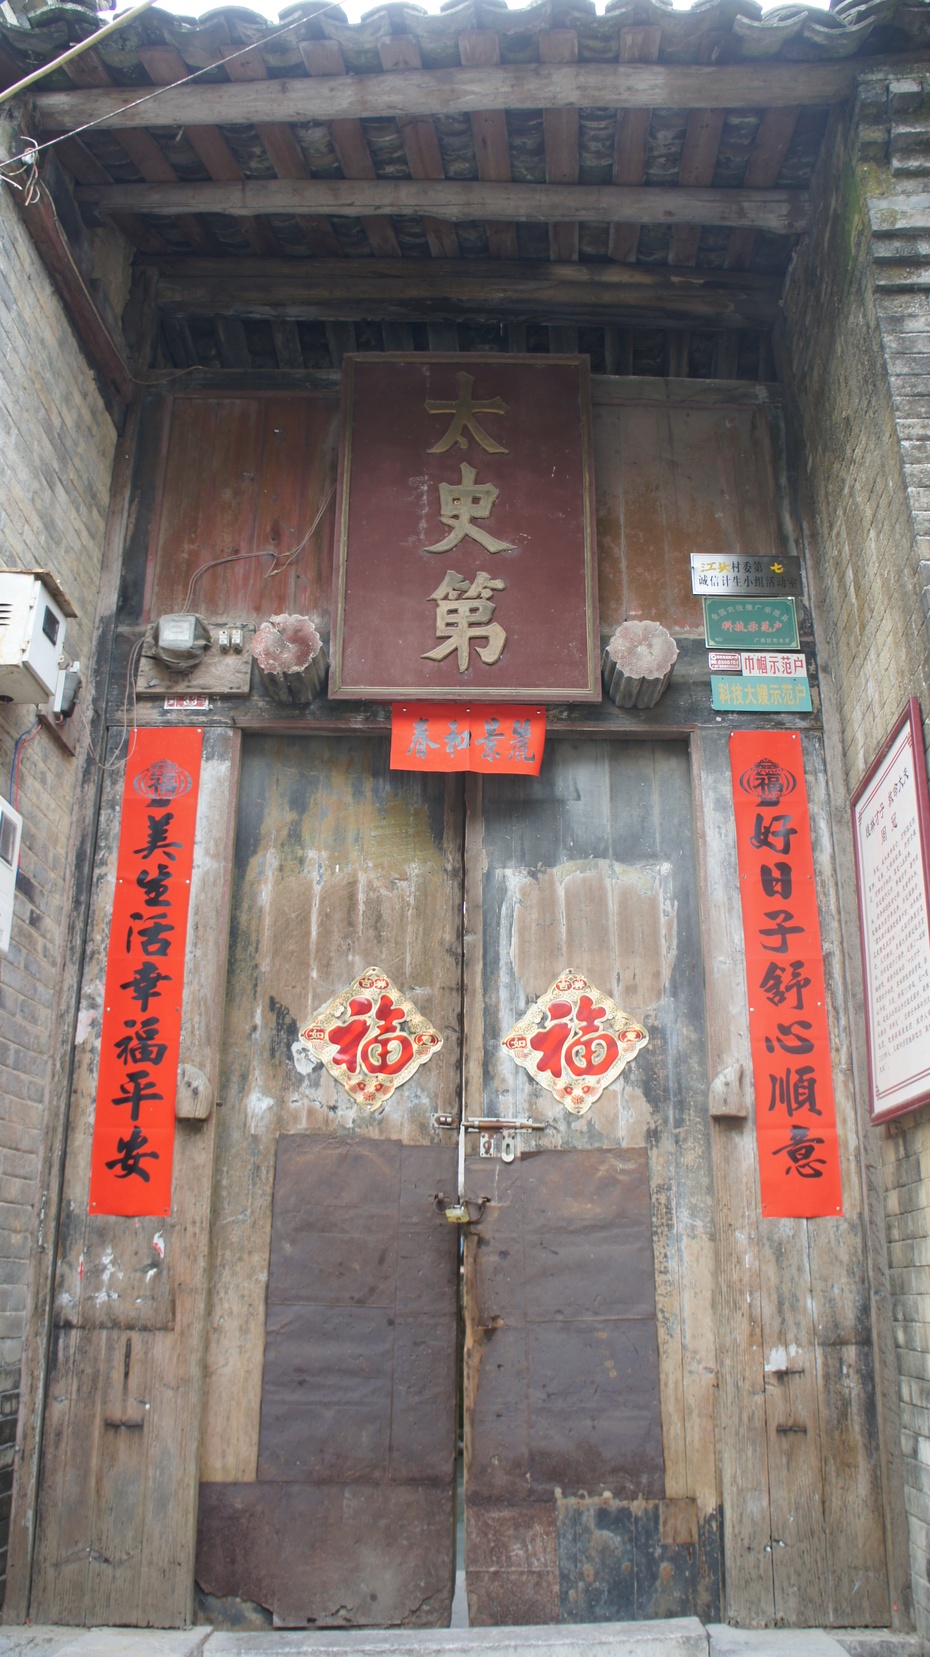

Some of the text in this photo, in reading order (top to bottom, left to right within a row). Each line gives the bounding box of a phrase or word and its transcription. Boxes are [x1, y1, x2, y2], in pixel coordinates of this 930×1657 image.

[420, 371, 517, 673] 太史第
[722, 620, 782, 632] 科技示范户
[744, 655, 804, 674] 巾帼示范户
[718, 683, 806, 705] 科技大嫂示范户
[105, 812, 184, 1182] 美生活幸福平安
[328, 994, 414, 1074] 福
[529, 994, 620, 1079] 福
